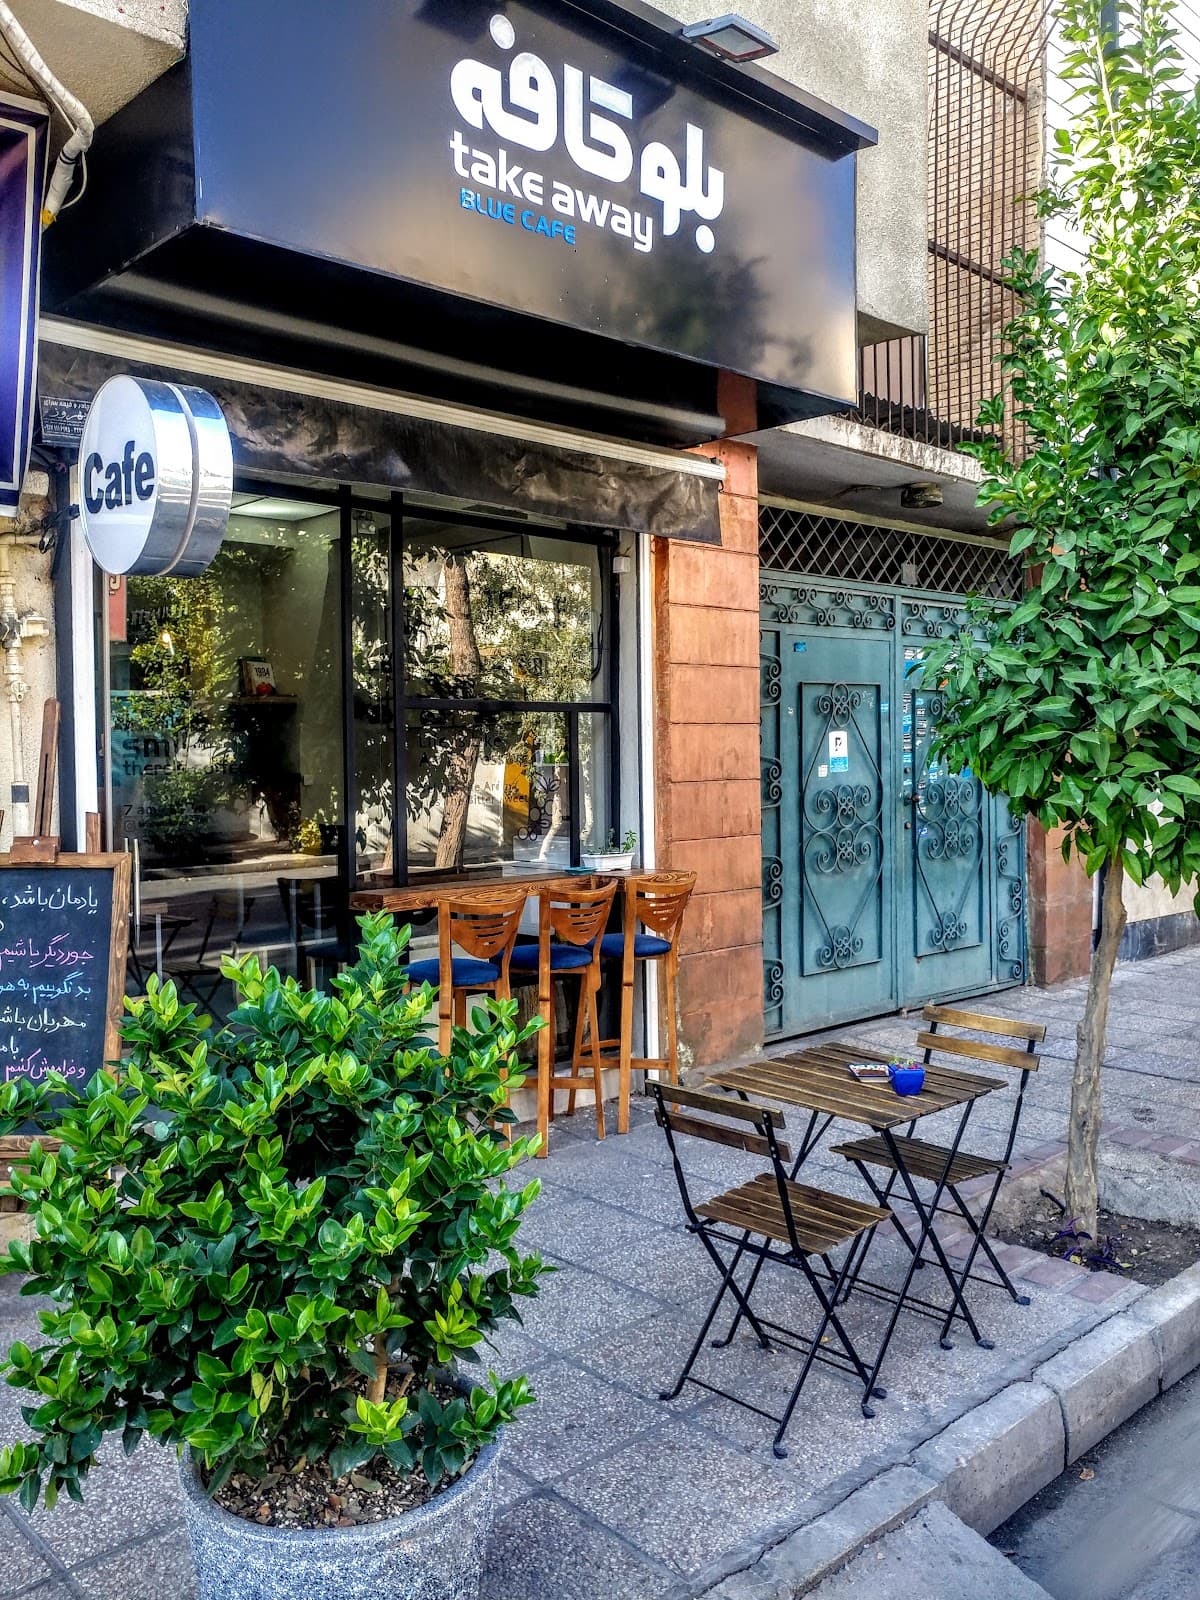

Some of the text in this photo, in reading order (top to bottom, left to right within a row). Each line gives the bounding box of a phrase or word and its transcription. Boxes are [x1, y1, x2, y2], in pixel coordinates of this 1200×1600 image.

[450, 14, 724, 253] بلو کافه
[450, 130, 654, 253] take away
[460, 187, 577, 246] BLUE CAFE
[84, 440, 156, 514] Cafe
[48, 884, 99, 915] یادمان
[17, 978, 30, 998] به
[26, 1007, 87, 1034] مهربان
